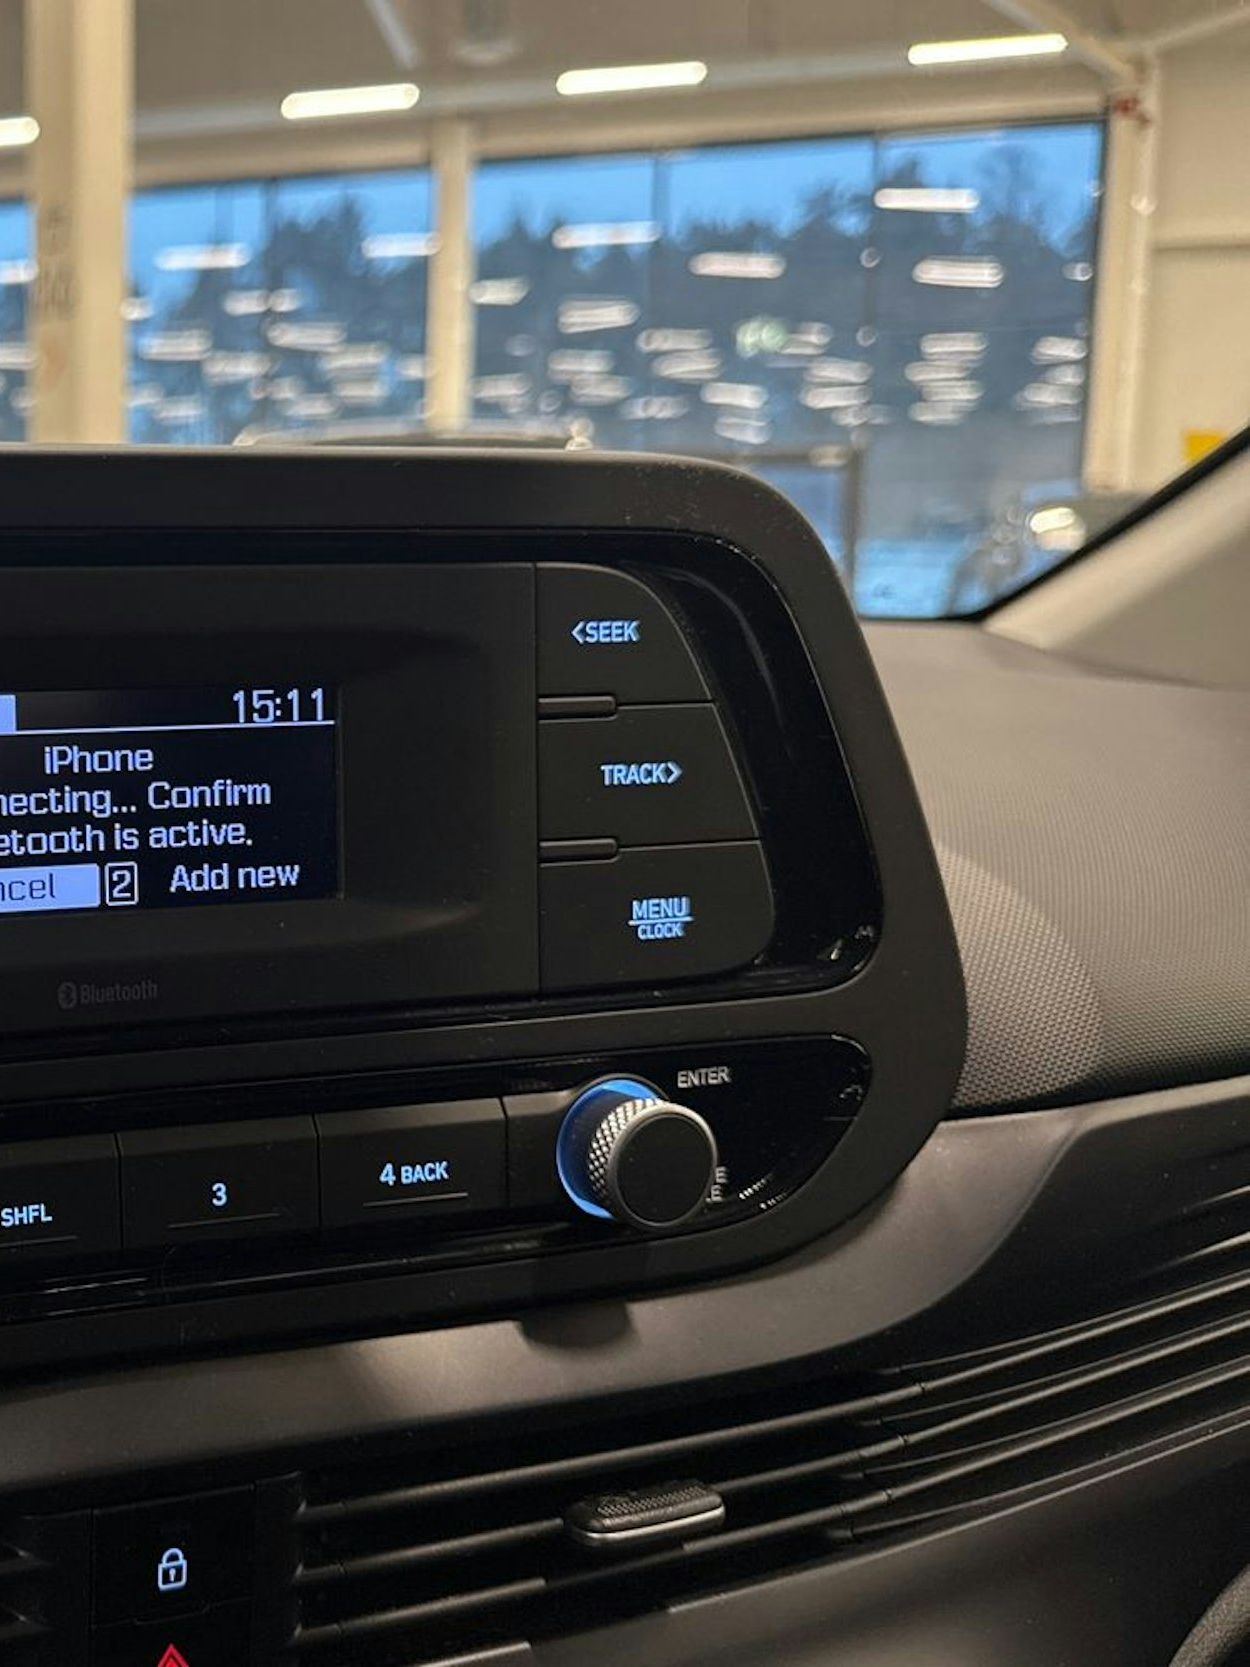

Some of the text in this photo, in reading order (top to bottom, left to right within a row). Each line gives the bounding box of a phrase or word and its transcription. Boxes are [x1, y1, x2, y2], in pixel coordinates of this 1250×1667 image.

[232, 687, 325, 724] 15:11
[44, 745, 154, 775] iPhone
[148, 779, 272, 810] Confirm
[114, 823, 140, 851] is
[149, 818, 254, 849] active.
[112, 862, 300, 898] 2 Add new
[632, 896, 691, 919] MENU
[637, 922, 684, 940] CLOCK
[80, 980, 158, 1004] Bluetooth
[677, 1066, 731, 1089] ENTER
[379, 1160, 449, 1187] 4 BACK
[211, 1182, 228, 1207] 3
[0, 1203, 53, 1228] SHFL
